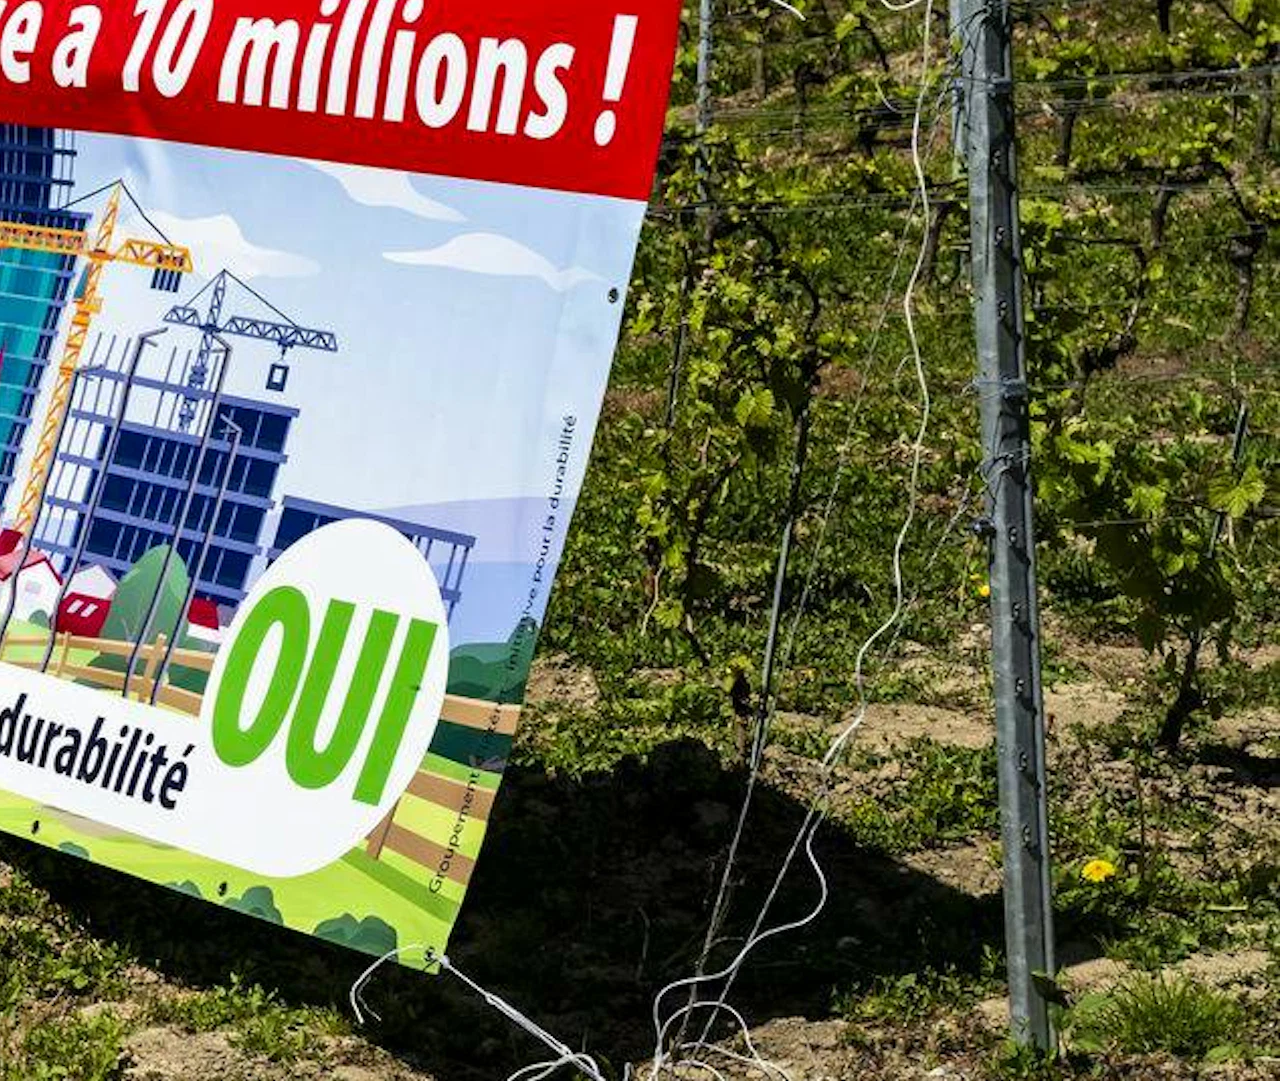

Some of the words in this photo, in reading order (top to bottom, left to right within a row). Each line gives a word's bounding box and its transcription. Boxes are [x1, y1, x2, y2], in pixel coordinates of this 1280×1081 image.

[594, 14, 638, 146] !
[212, 586, 438, 805] OUI
[429, 772, 480, 894] Groupement
[534, 534, 551, 582] pour
[543, 515, 556, 533] la
[550, 415, 577, 509] durabilité
